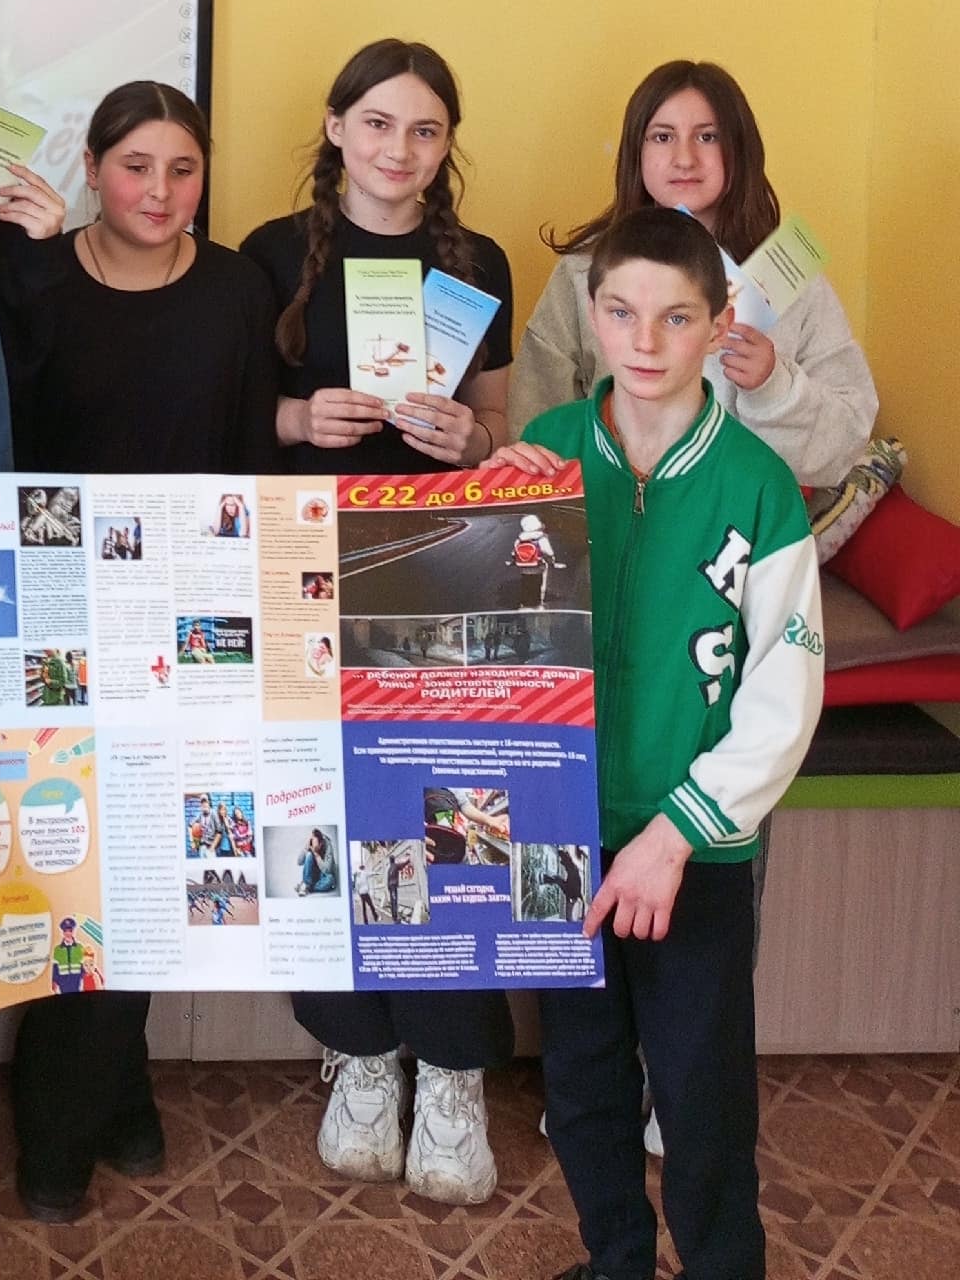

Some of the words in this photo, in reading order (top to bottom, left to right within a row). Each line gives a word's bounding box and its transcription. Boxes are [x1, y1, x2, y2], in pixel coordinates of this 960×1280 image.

[349, 486, 369, 506] С
[378, 486, 417, 506] 22
[425, 491, 456, 507] до
[464, 481, 483, 502] 6
[491, 483, 573, 498] часов...
[420, 671, 468, 680] должен
[470, 670, 540, 680] находиться
[542, 671, 581, 681] дома!
[376, 680, 415, 690] Улица
[424, 680, 452, 688] зона
[454, 680, 556, 689] ответственности
[420, 686, 511, 699] РОДИТЕЛЕЙ!
[266, 783, 323, 806] Подросток
[324, 780, 332, 791] и
[288, 803, 316, 819] закон
